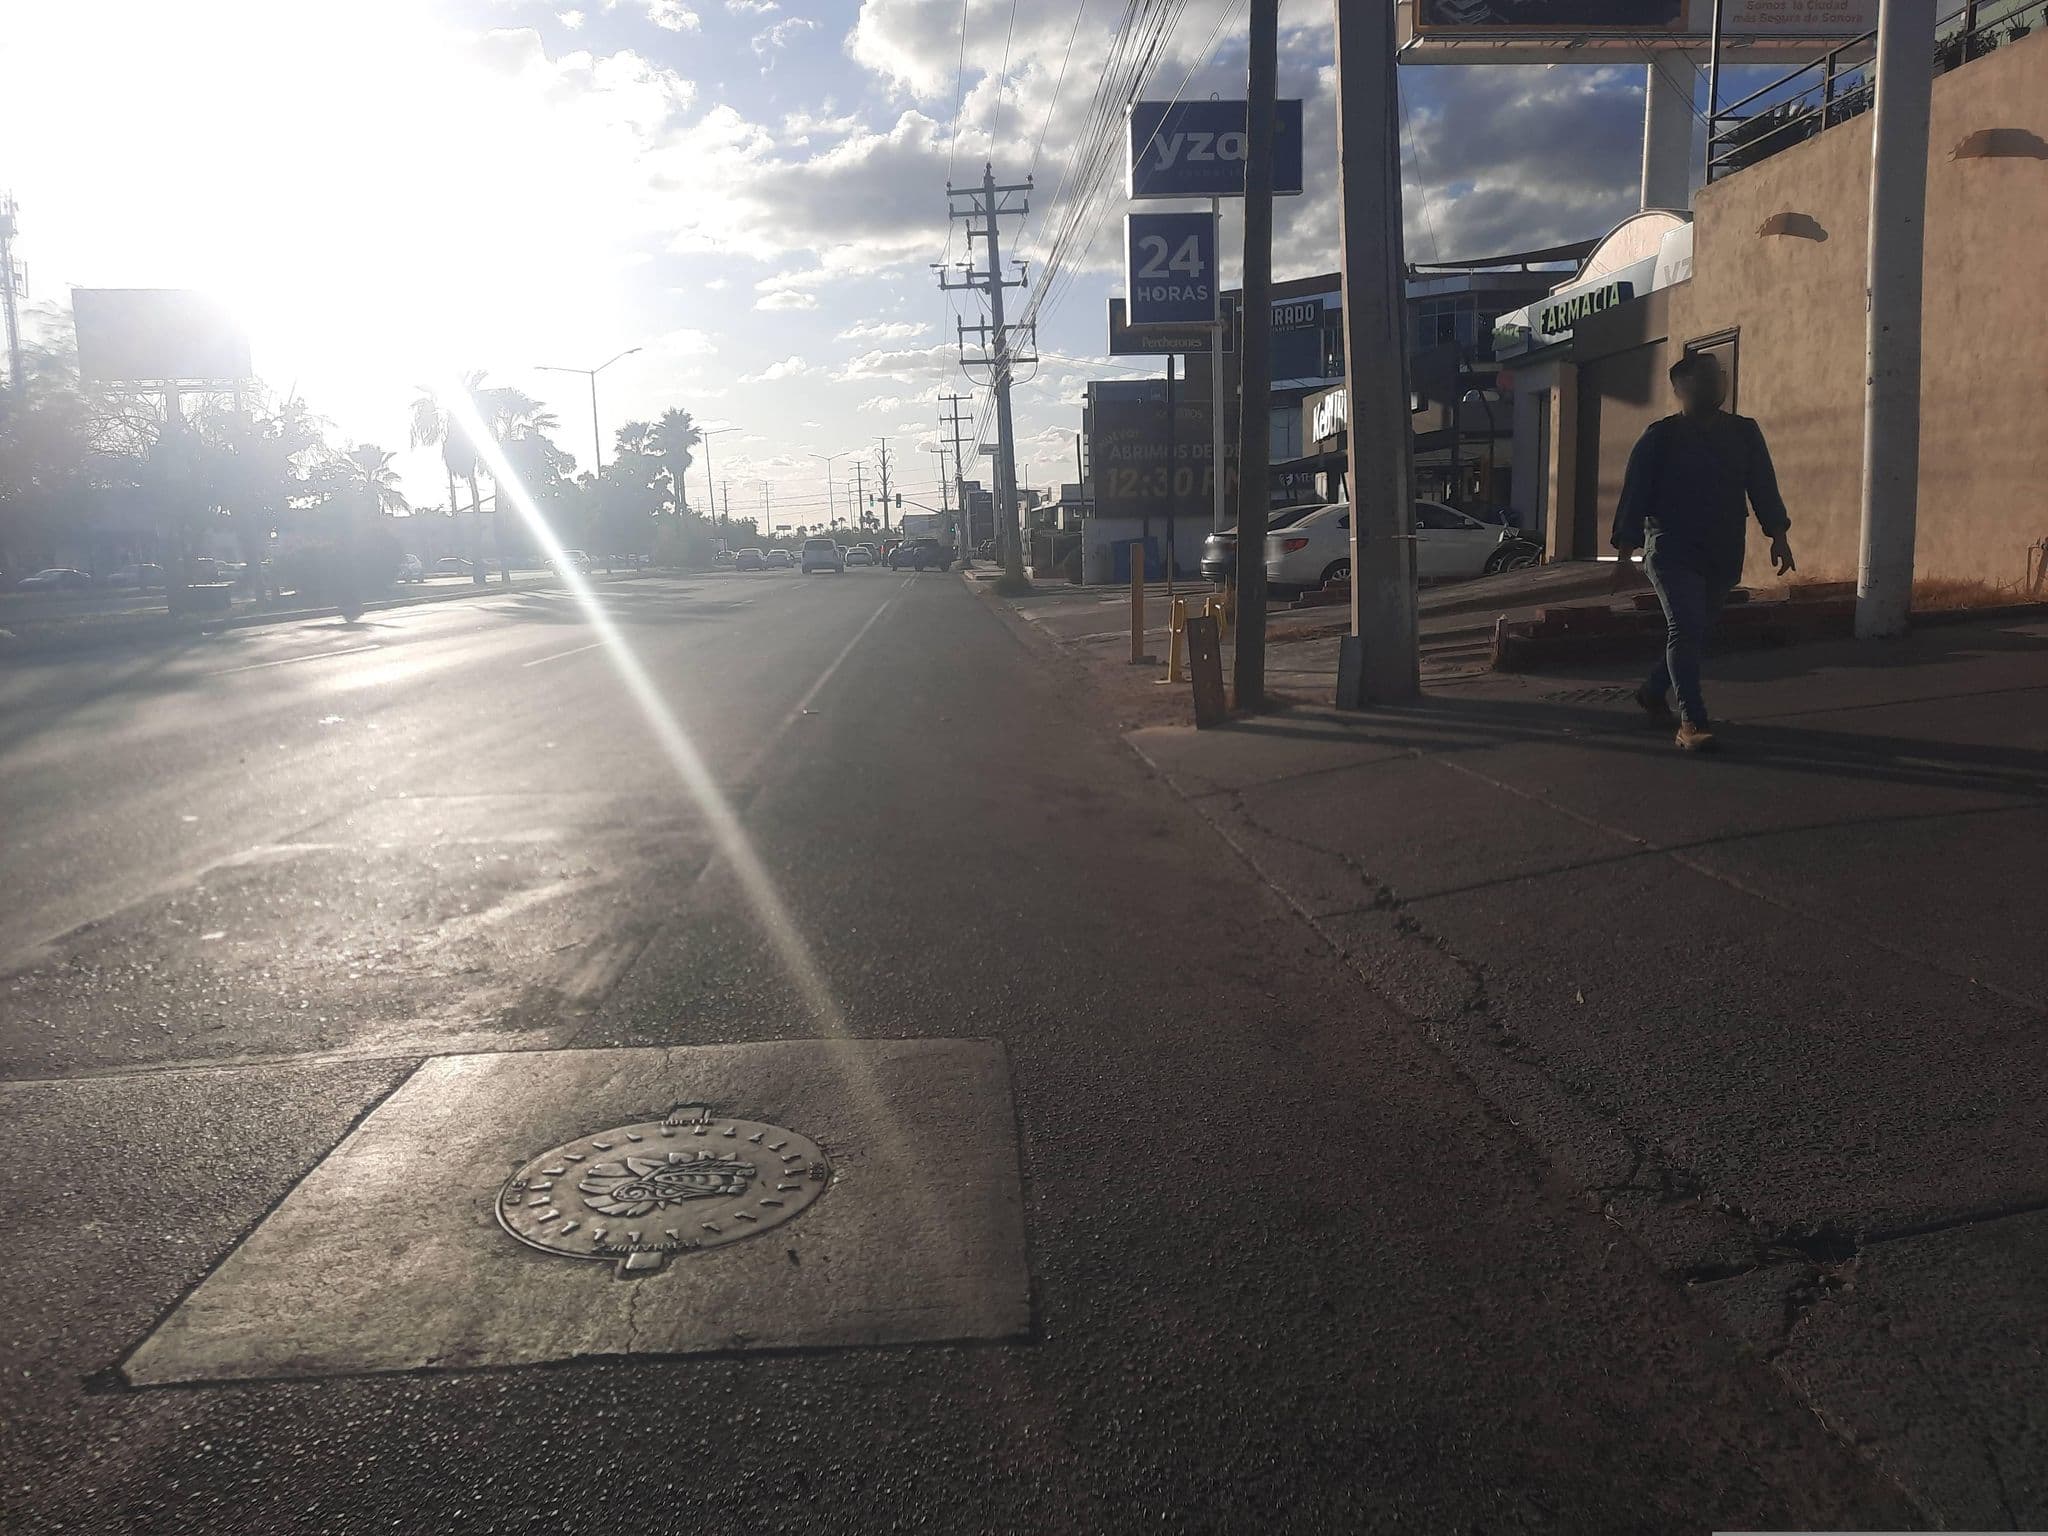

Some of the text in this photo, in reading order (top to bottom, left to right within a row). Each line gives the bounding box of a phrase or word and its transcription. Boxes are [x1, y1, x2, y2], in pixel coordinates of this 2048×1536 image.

[1747, 0, 1786, 9] Somos
[1807, 0, 1848, 9] Ciudad
[1804, 13, 1818, 22] de
[1823, 13, 1863, 22] Sonora
[1153, 131, 1248, 170] yza
[1136, 234, 1204, 278] 24
[1137, 285, 1208, 302] HORAS
[1539, 281, 1620, 336] FARMACIA
[1107, 467, 1194, 497] 12:30
